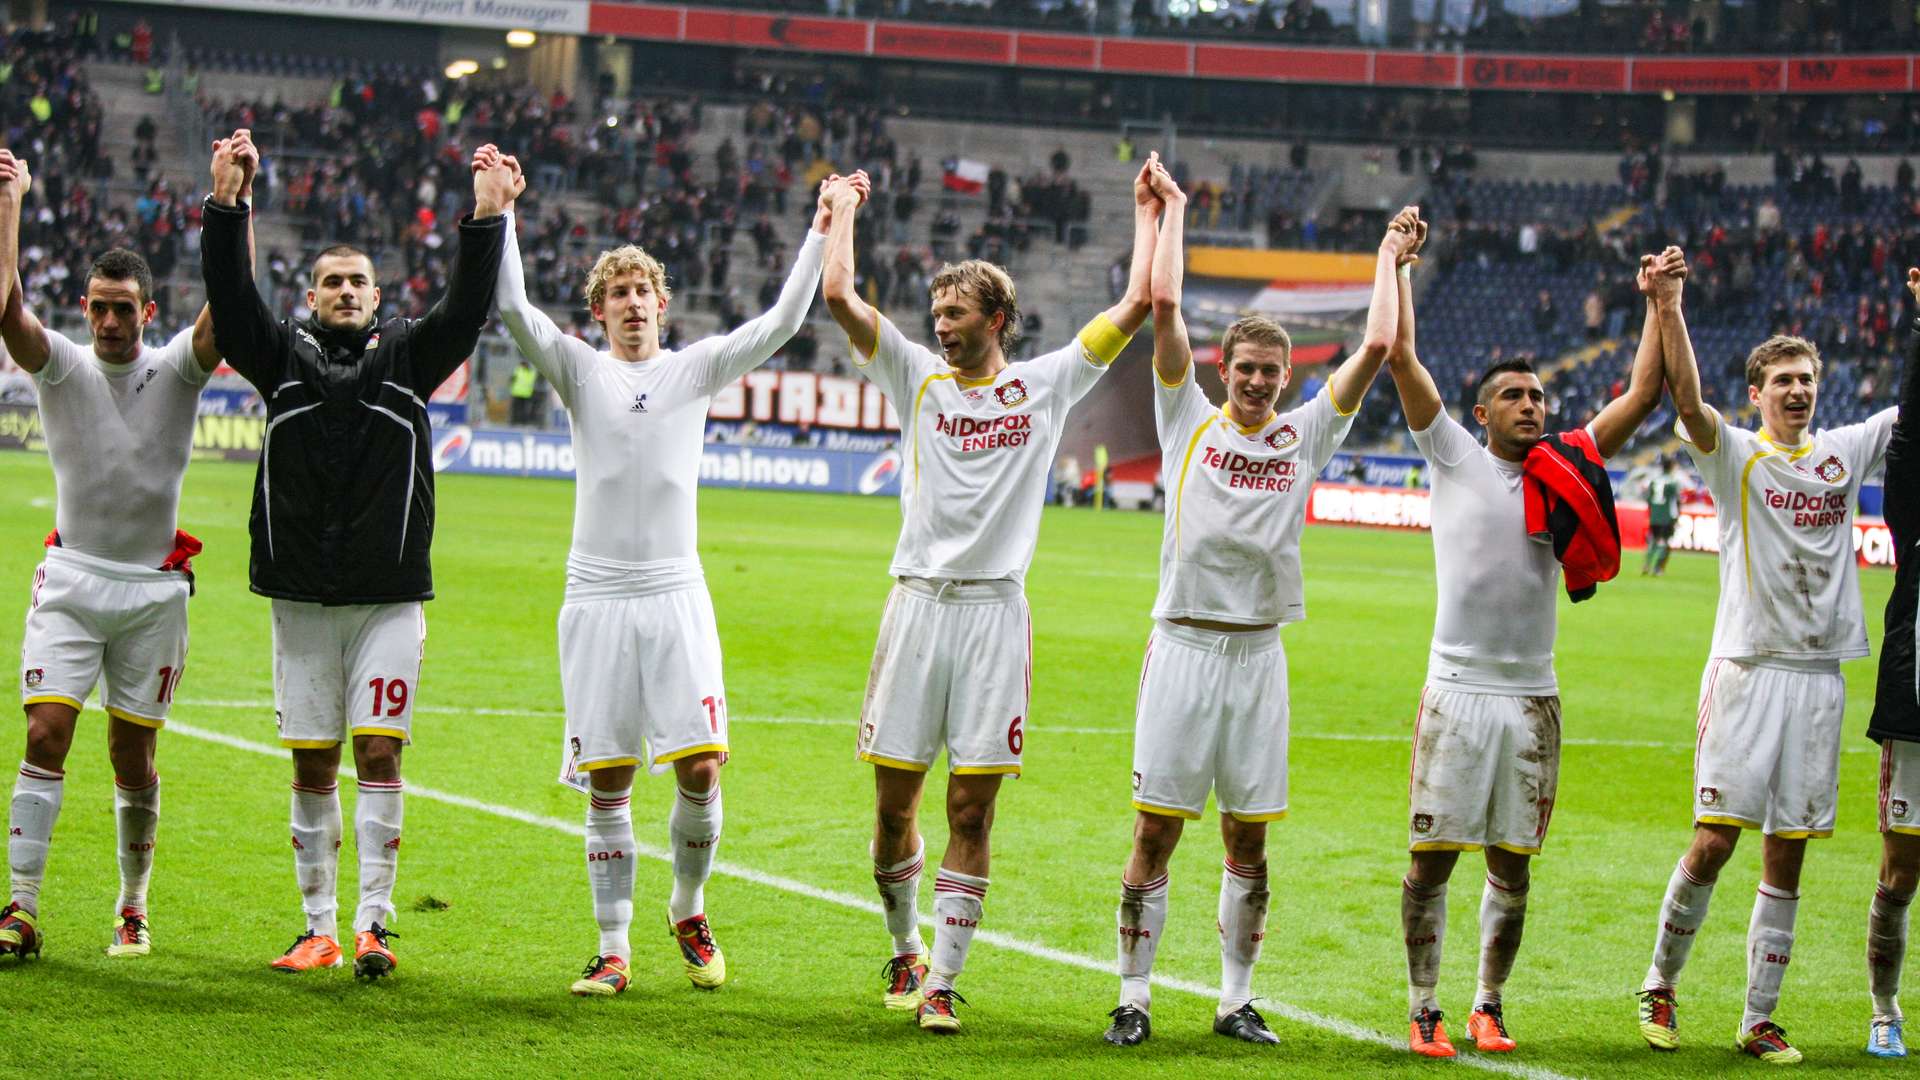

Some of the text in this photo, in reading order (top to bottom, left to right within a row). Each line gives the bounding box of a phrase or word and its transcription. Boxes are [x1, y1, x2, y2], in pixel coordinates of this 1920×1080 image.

[936, 413, 1032, 437] TelDaFax
[962, 431, 1031, 452] ENERGY
[1202, 446, 1297, 476] TelDaFax
[1229, 474, 1295, 492] ENERGY
[1765, 488, 1846, 511] TelDaFax
[1793, 510, 1847, 527] ENERGY
[369, 677, 408, 717] 19
[1007, 715, 1024, 756] 6
